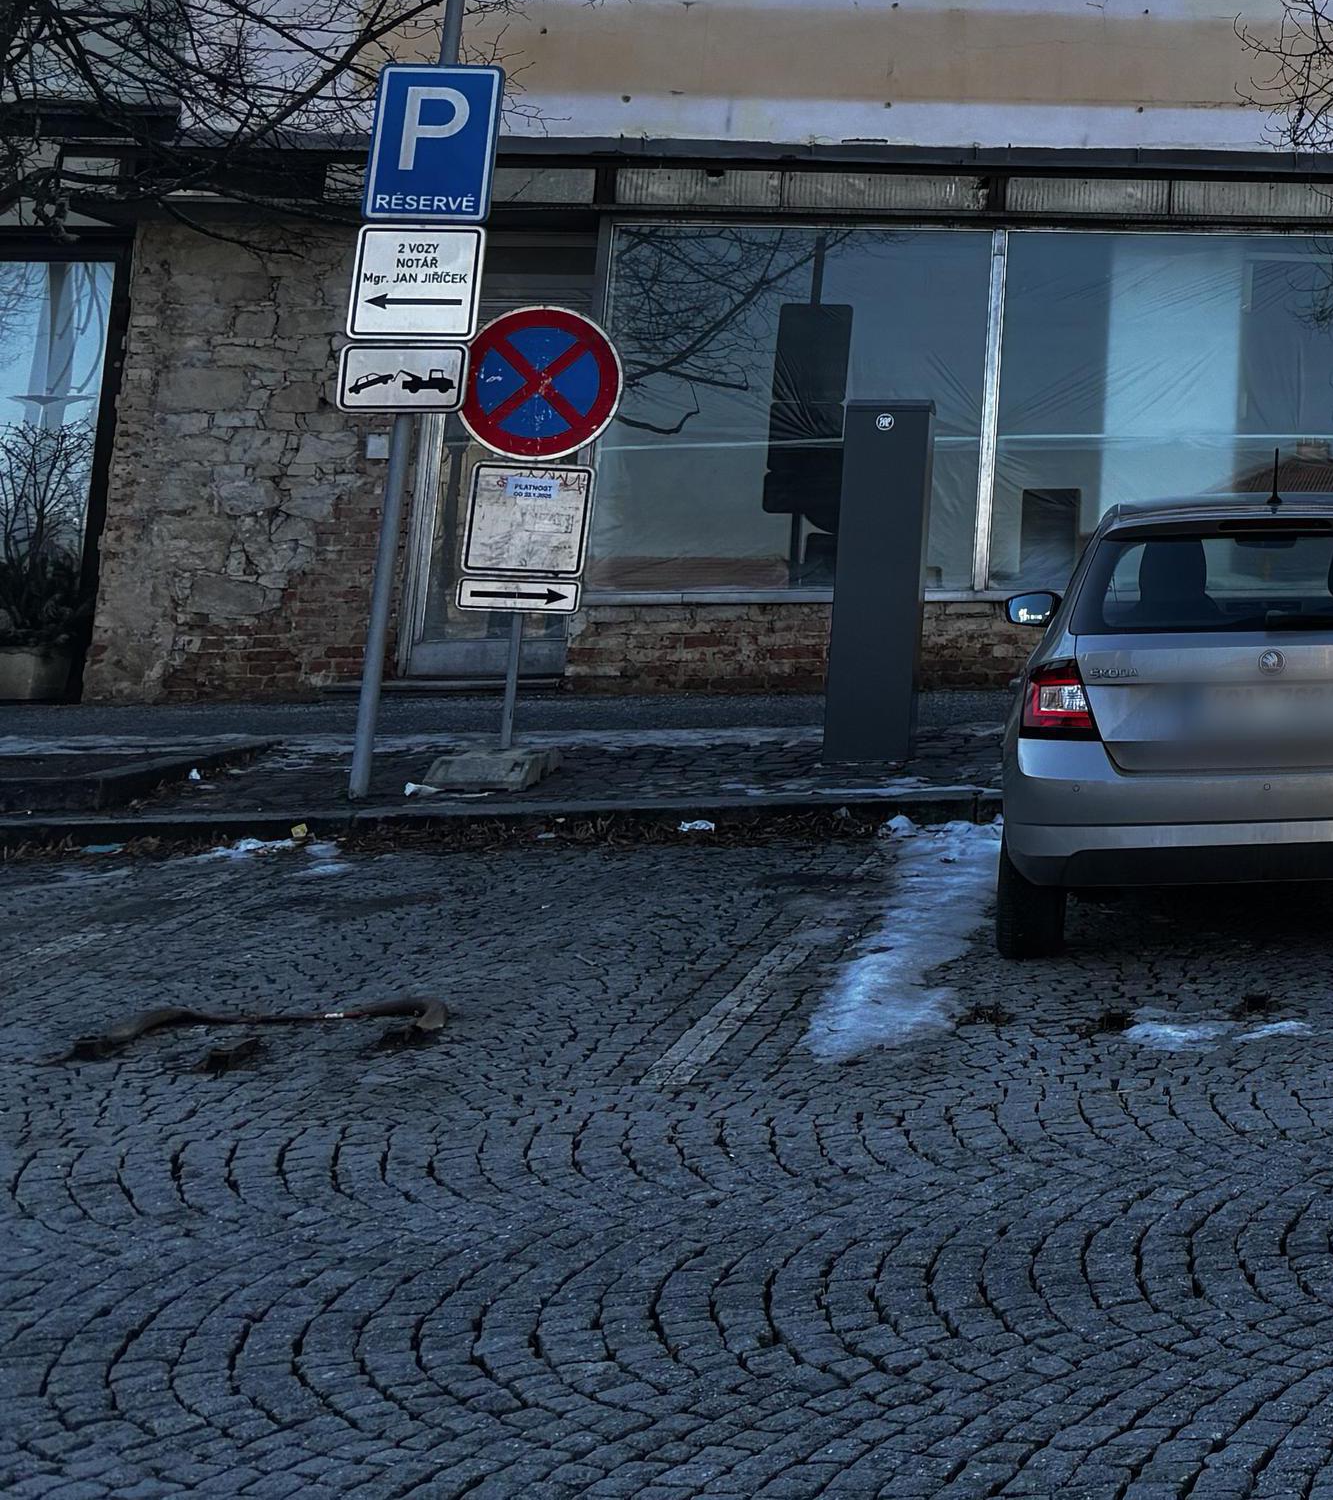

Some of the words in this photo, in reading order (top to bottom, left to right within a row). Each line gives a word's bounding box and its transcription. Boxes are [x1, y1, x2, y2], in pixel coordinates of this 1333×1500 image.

[398, 86, 470, 171] P
[375, 192, 475, 212] RÉSERVÉ
[397, 243, 406, 254] 2
[409, 243, 440, 254] VOZY
[396, 256, 439, 269] NOTÁŘ
[363, 272, 389, 285] Mgr.
[392, 273, 418, 284] JAN
[420, 271, 468, 284] JIŘÍČEK
[514, 483, 553, 493] PLATNOST
